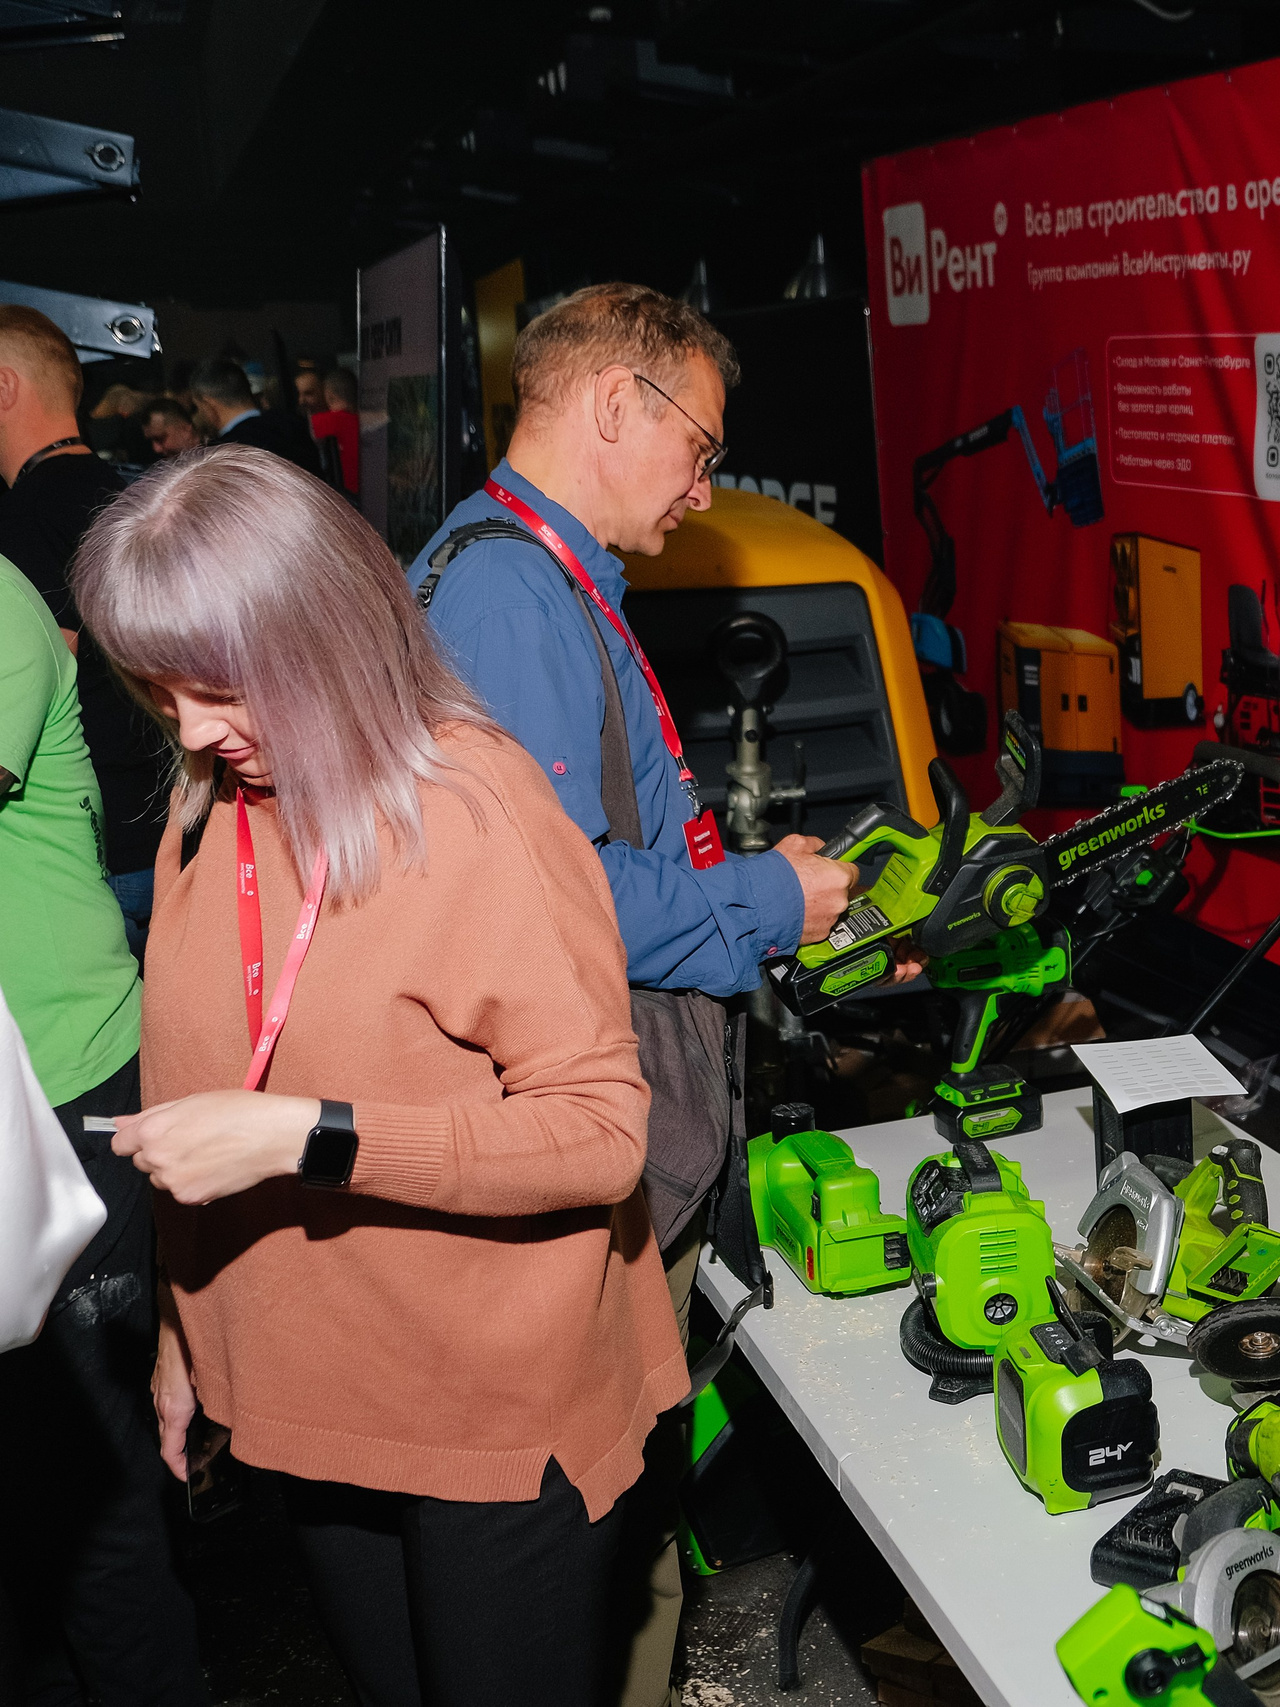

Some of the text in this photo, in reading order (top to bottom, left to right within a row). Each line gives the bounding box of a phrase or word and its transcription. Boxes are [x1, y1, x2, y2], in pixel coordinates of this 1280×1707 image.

[1024, 200, 1052, 238] Всё
[1055, 204, 1084, 239] для
[1087, 184, 1220, 238] строительства
[1226, 183, 1238, 212] в
[1027, 261, 1063, 292] Группа
[1058, 803, 1166, 871] greenworks
[246, 863, 255, 879] Все
[296, 923, 307, 940] Все
[252, 962, 261, 978] Все
[259, 1035, 270, 1052] Все
[1088, 1441, 1134, 1467] 24V
[1225, 1546, 1274, 1580] greenworks
